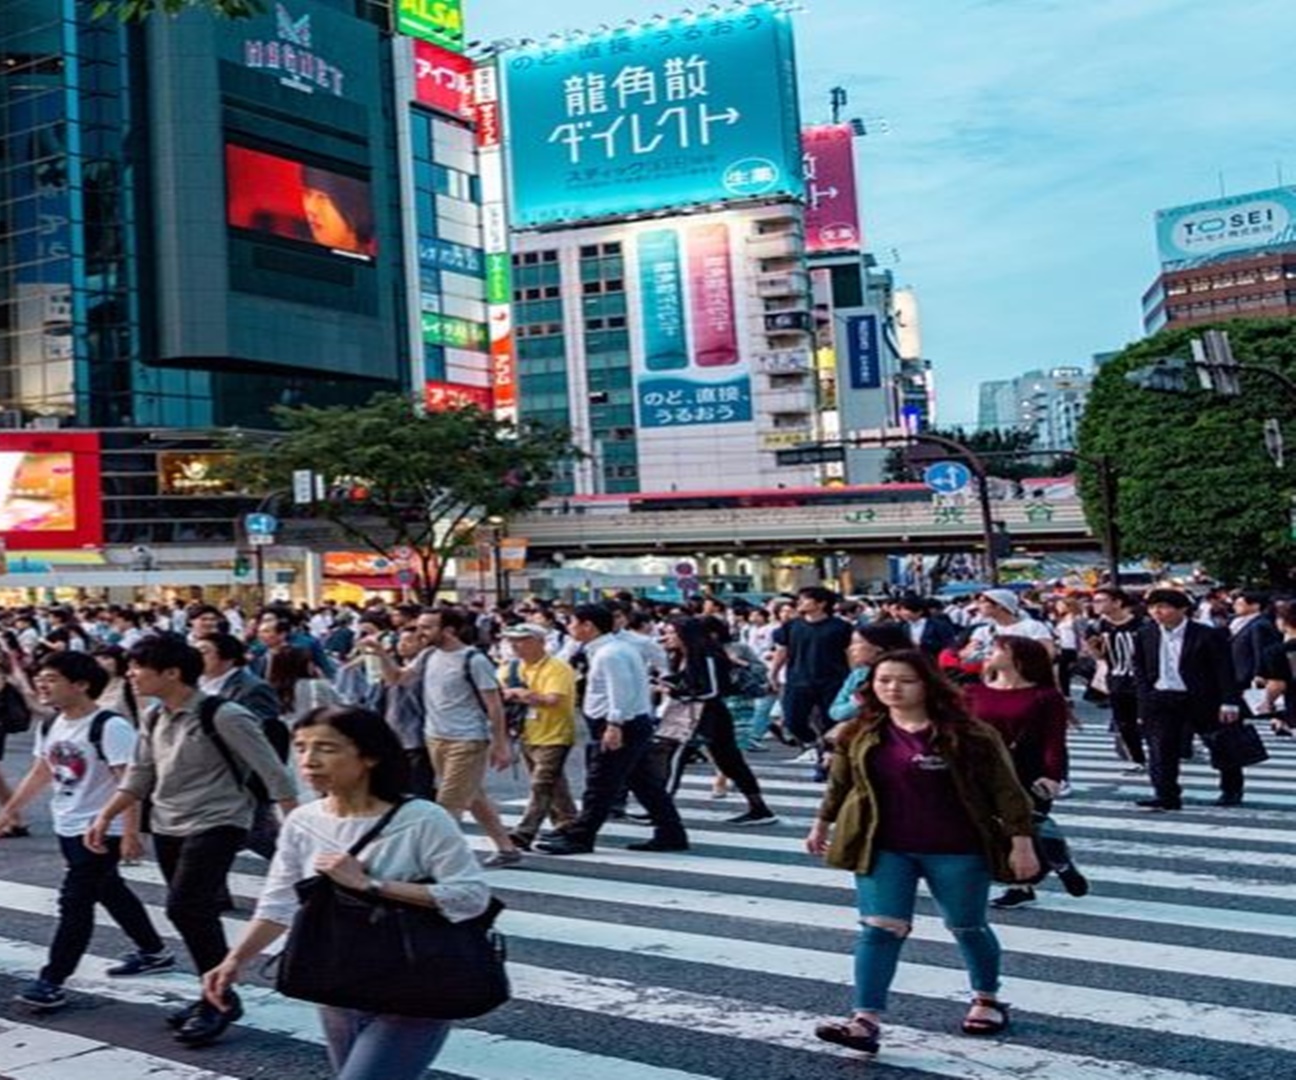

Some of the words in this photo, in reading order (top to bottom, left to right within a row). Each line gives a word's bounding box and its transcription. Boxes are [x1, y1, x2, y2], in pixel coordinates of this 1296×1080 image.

[245, 40, 344, 97] MAGNET
[563, 54, 710, 118] 龍角散
[547, 103, 741, 164] ダイレクト
[1184, 208, 1274, 236] TOSEI
[656, 403, 735, 425] うるおう
